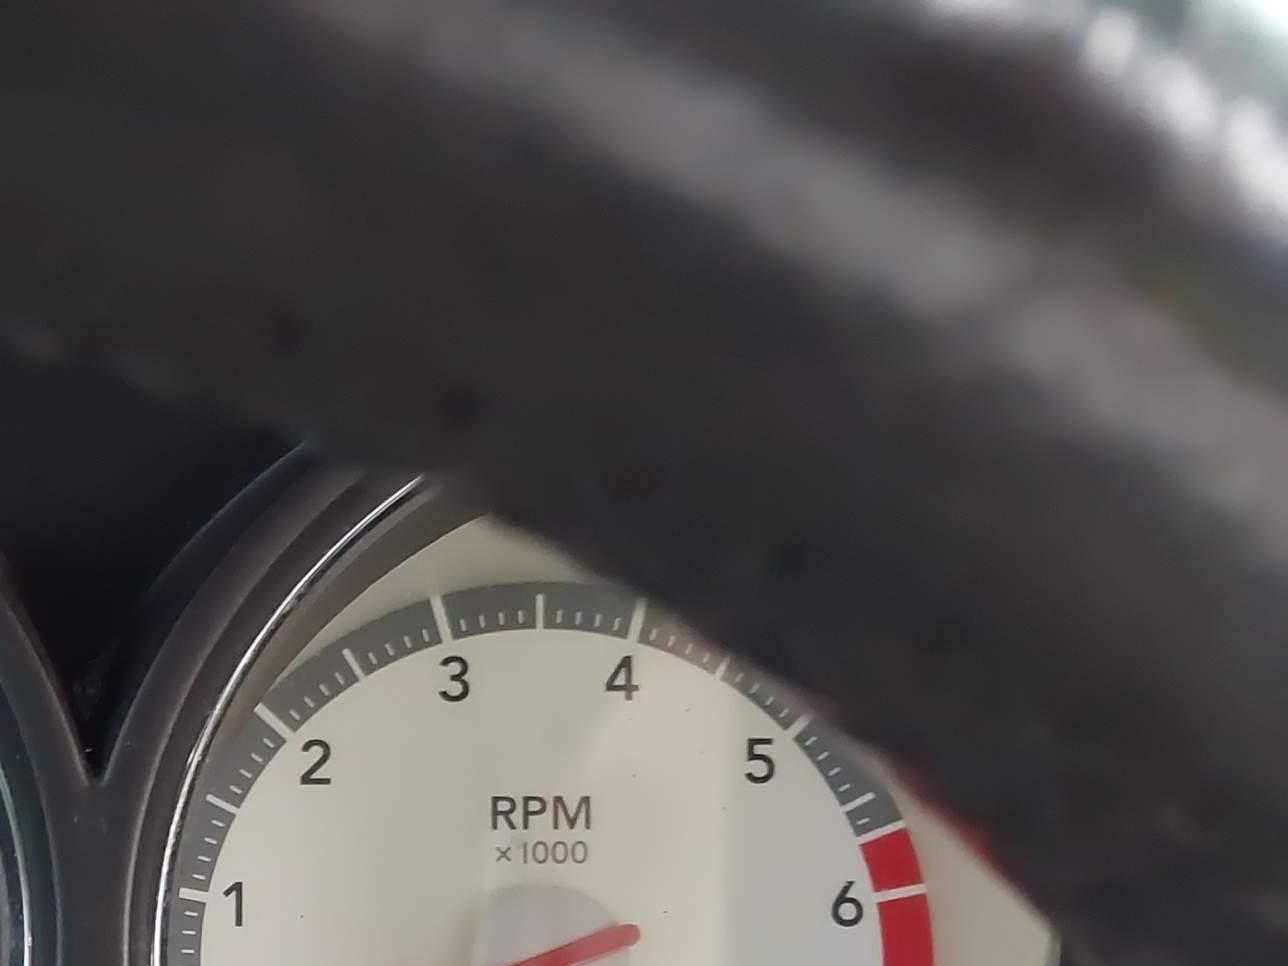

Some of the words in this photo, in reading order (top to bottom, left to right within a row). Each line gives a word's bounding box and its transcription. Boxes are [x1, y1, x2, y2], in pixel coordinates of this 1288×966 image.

[438, 656, 471, 703] 3
[605, 656, 639, 701] 4
[299, 739, 332, 785] 2
[744, 737, 776, 784] 5
[491, 796, 592, 831] RPM
[223, 881, 244, 927] 1
[831, 880, 864, 927] 6
